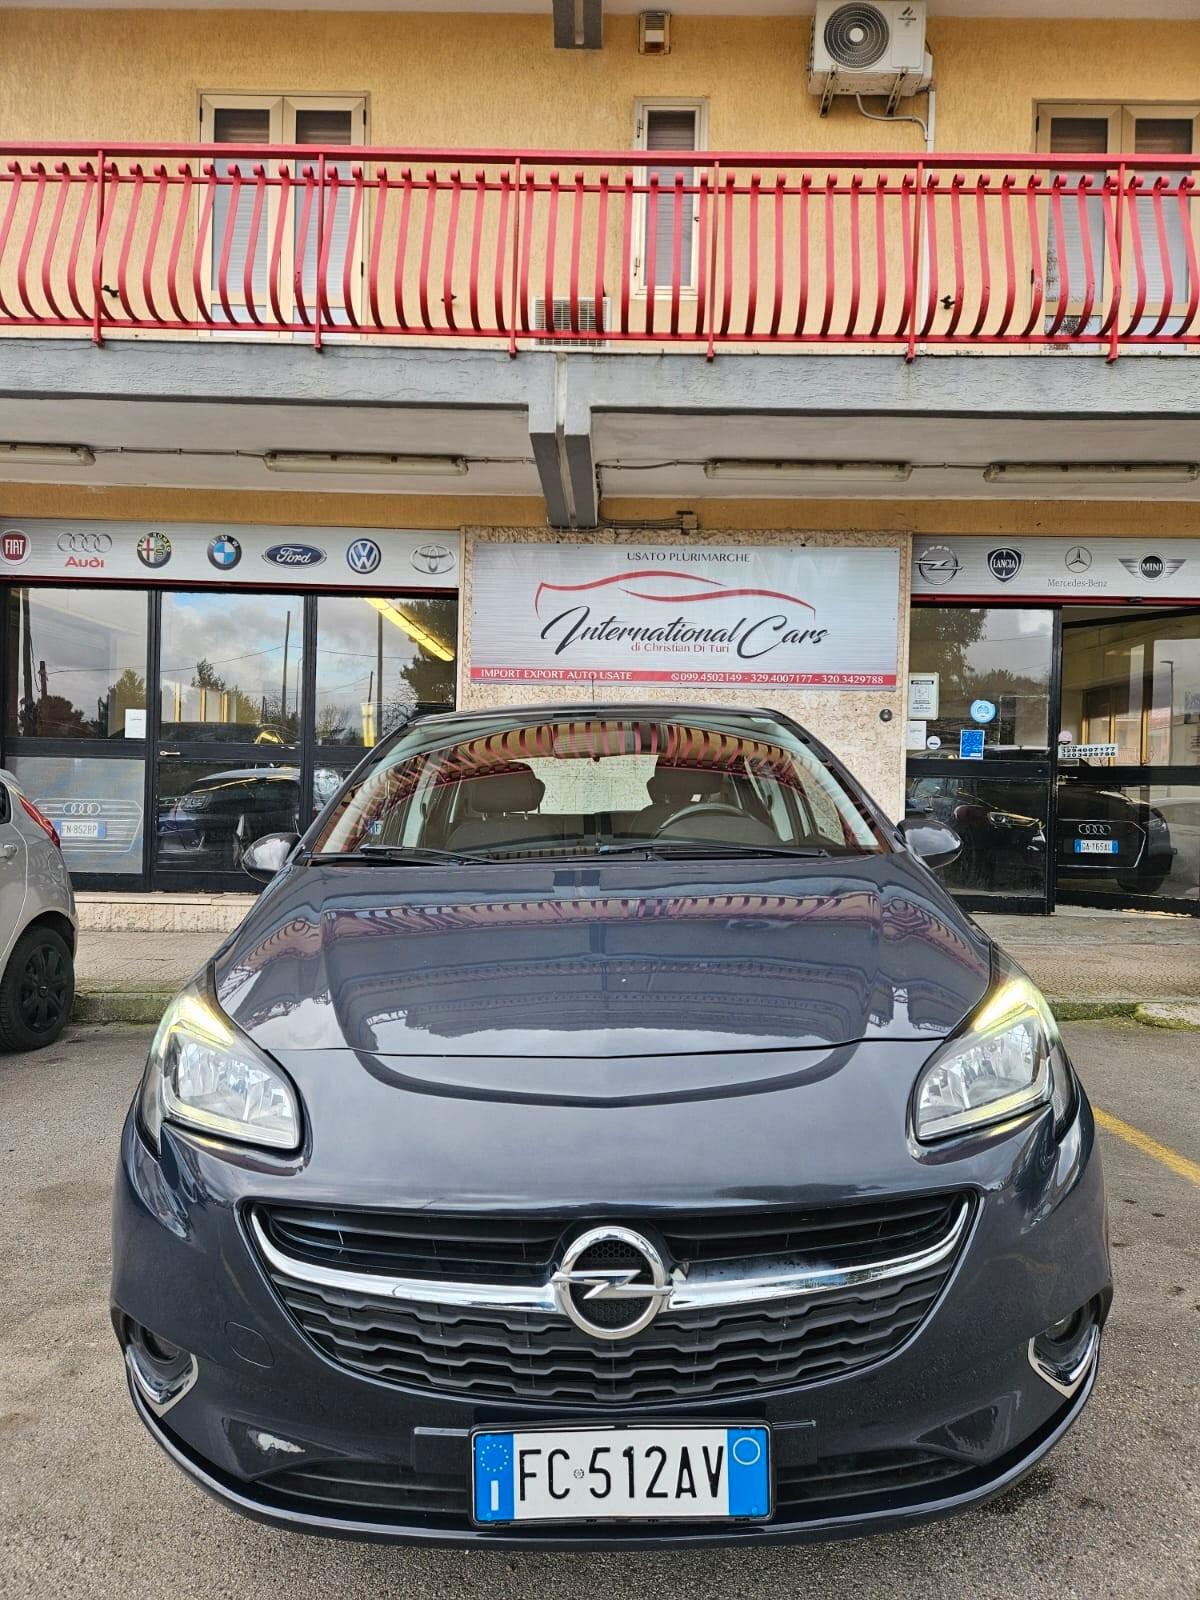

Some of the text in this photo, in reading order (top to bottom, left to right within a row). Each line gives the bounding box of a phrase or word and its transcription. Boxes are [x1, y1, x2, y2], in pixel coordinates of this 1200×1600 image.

[5, 539, 25, 555] FIAT
[276, 547, 312, 563] Ford
[627, 552, 751, 562] USATO PLURIMARCHE
[65, 556, 105, 568] Audi
[993, 558, 1016, 569] LANCIA
[1141, 562, 1163, 572] MINI
[1047, 579, 1108, 588] Mercedes-Benz
[540, 605, 831, 659] International Cars
[631, 642, 730, 653] di Christian Di Turi
[481, 669, 633, 680] IMPORT EXPORT AUTO USATE
[680, 672, 742, 682] 099.4502149
[750, 673, 813, 683] 329.4007177
[822, 674, 885, 684] 320.3429788
